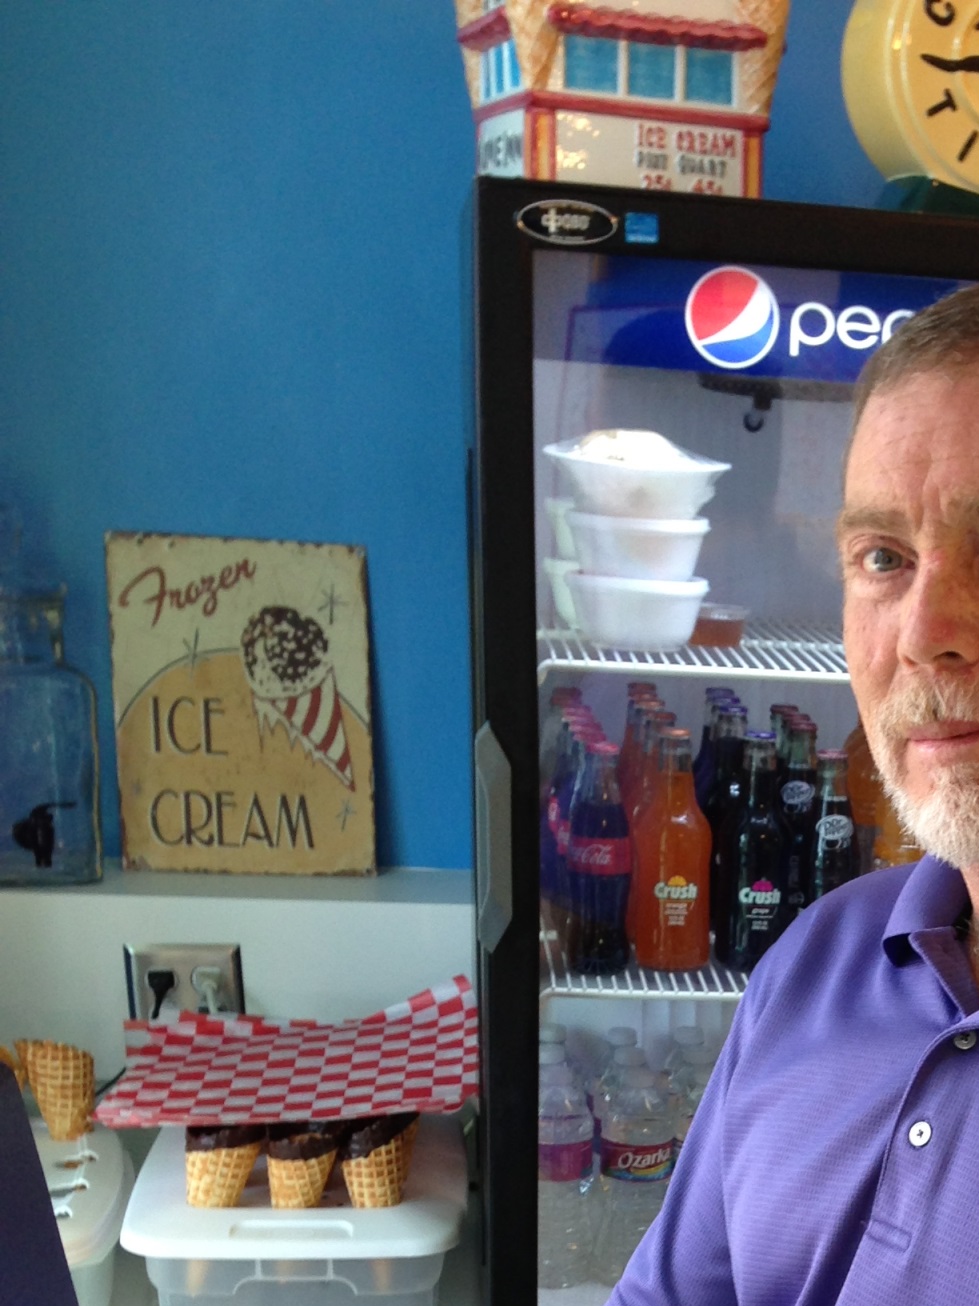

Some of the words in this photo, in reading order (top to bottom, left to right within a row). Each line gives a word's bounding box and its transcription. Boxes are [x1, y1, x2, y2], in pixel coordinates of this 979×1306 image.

[638, 123, 666, 149] ICE
[118, 557, 257, 627] Frozen
[151, 695, 227, 756] ICE
[150, 788, 315, 849] CREAM
[654, 881, 698, 900] Crush
[739, 886, 782, 905] Crush
